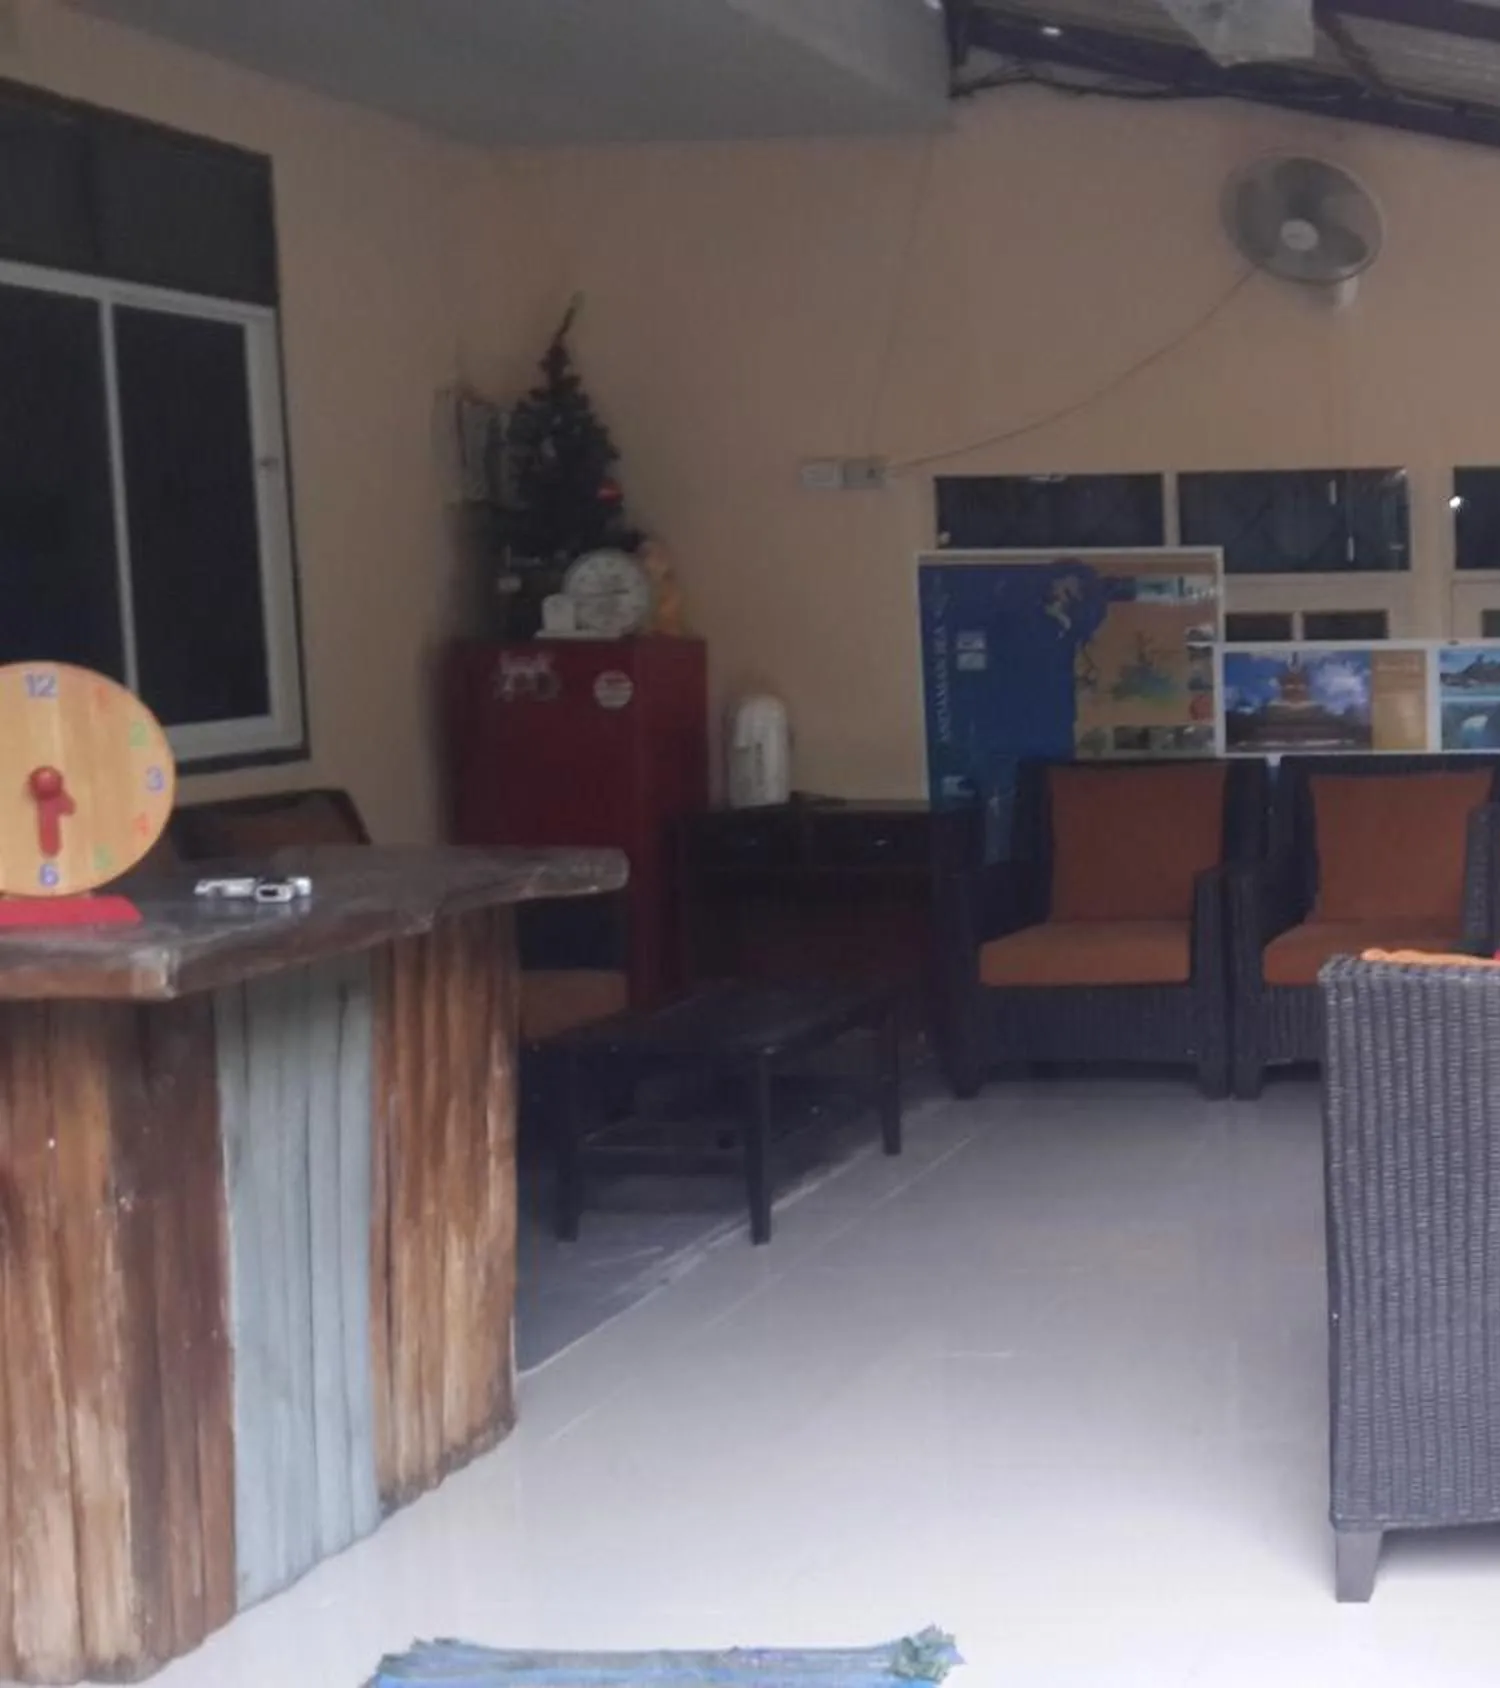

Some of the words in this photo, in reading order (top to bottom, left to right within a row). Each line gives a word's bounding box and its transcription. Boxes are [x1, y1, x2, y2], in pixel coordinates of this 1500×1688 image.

[25, 673, 57, 698] 12
[129, 722, 149, 748] 2
[146, 766, 165, 791] 3
[38, 864, 60, 887] 6
